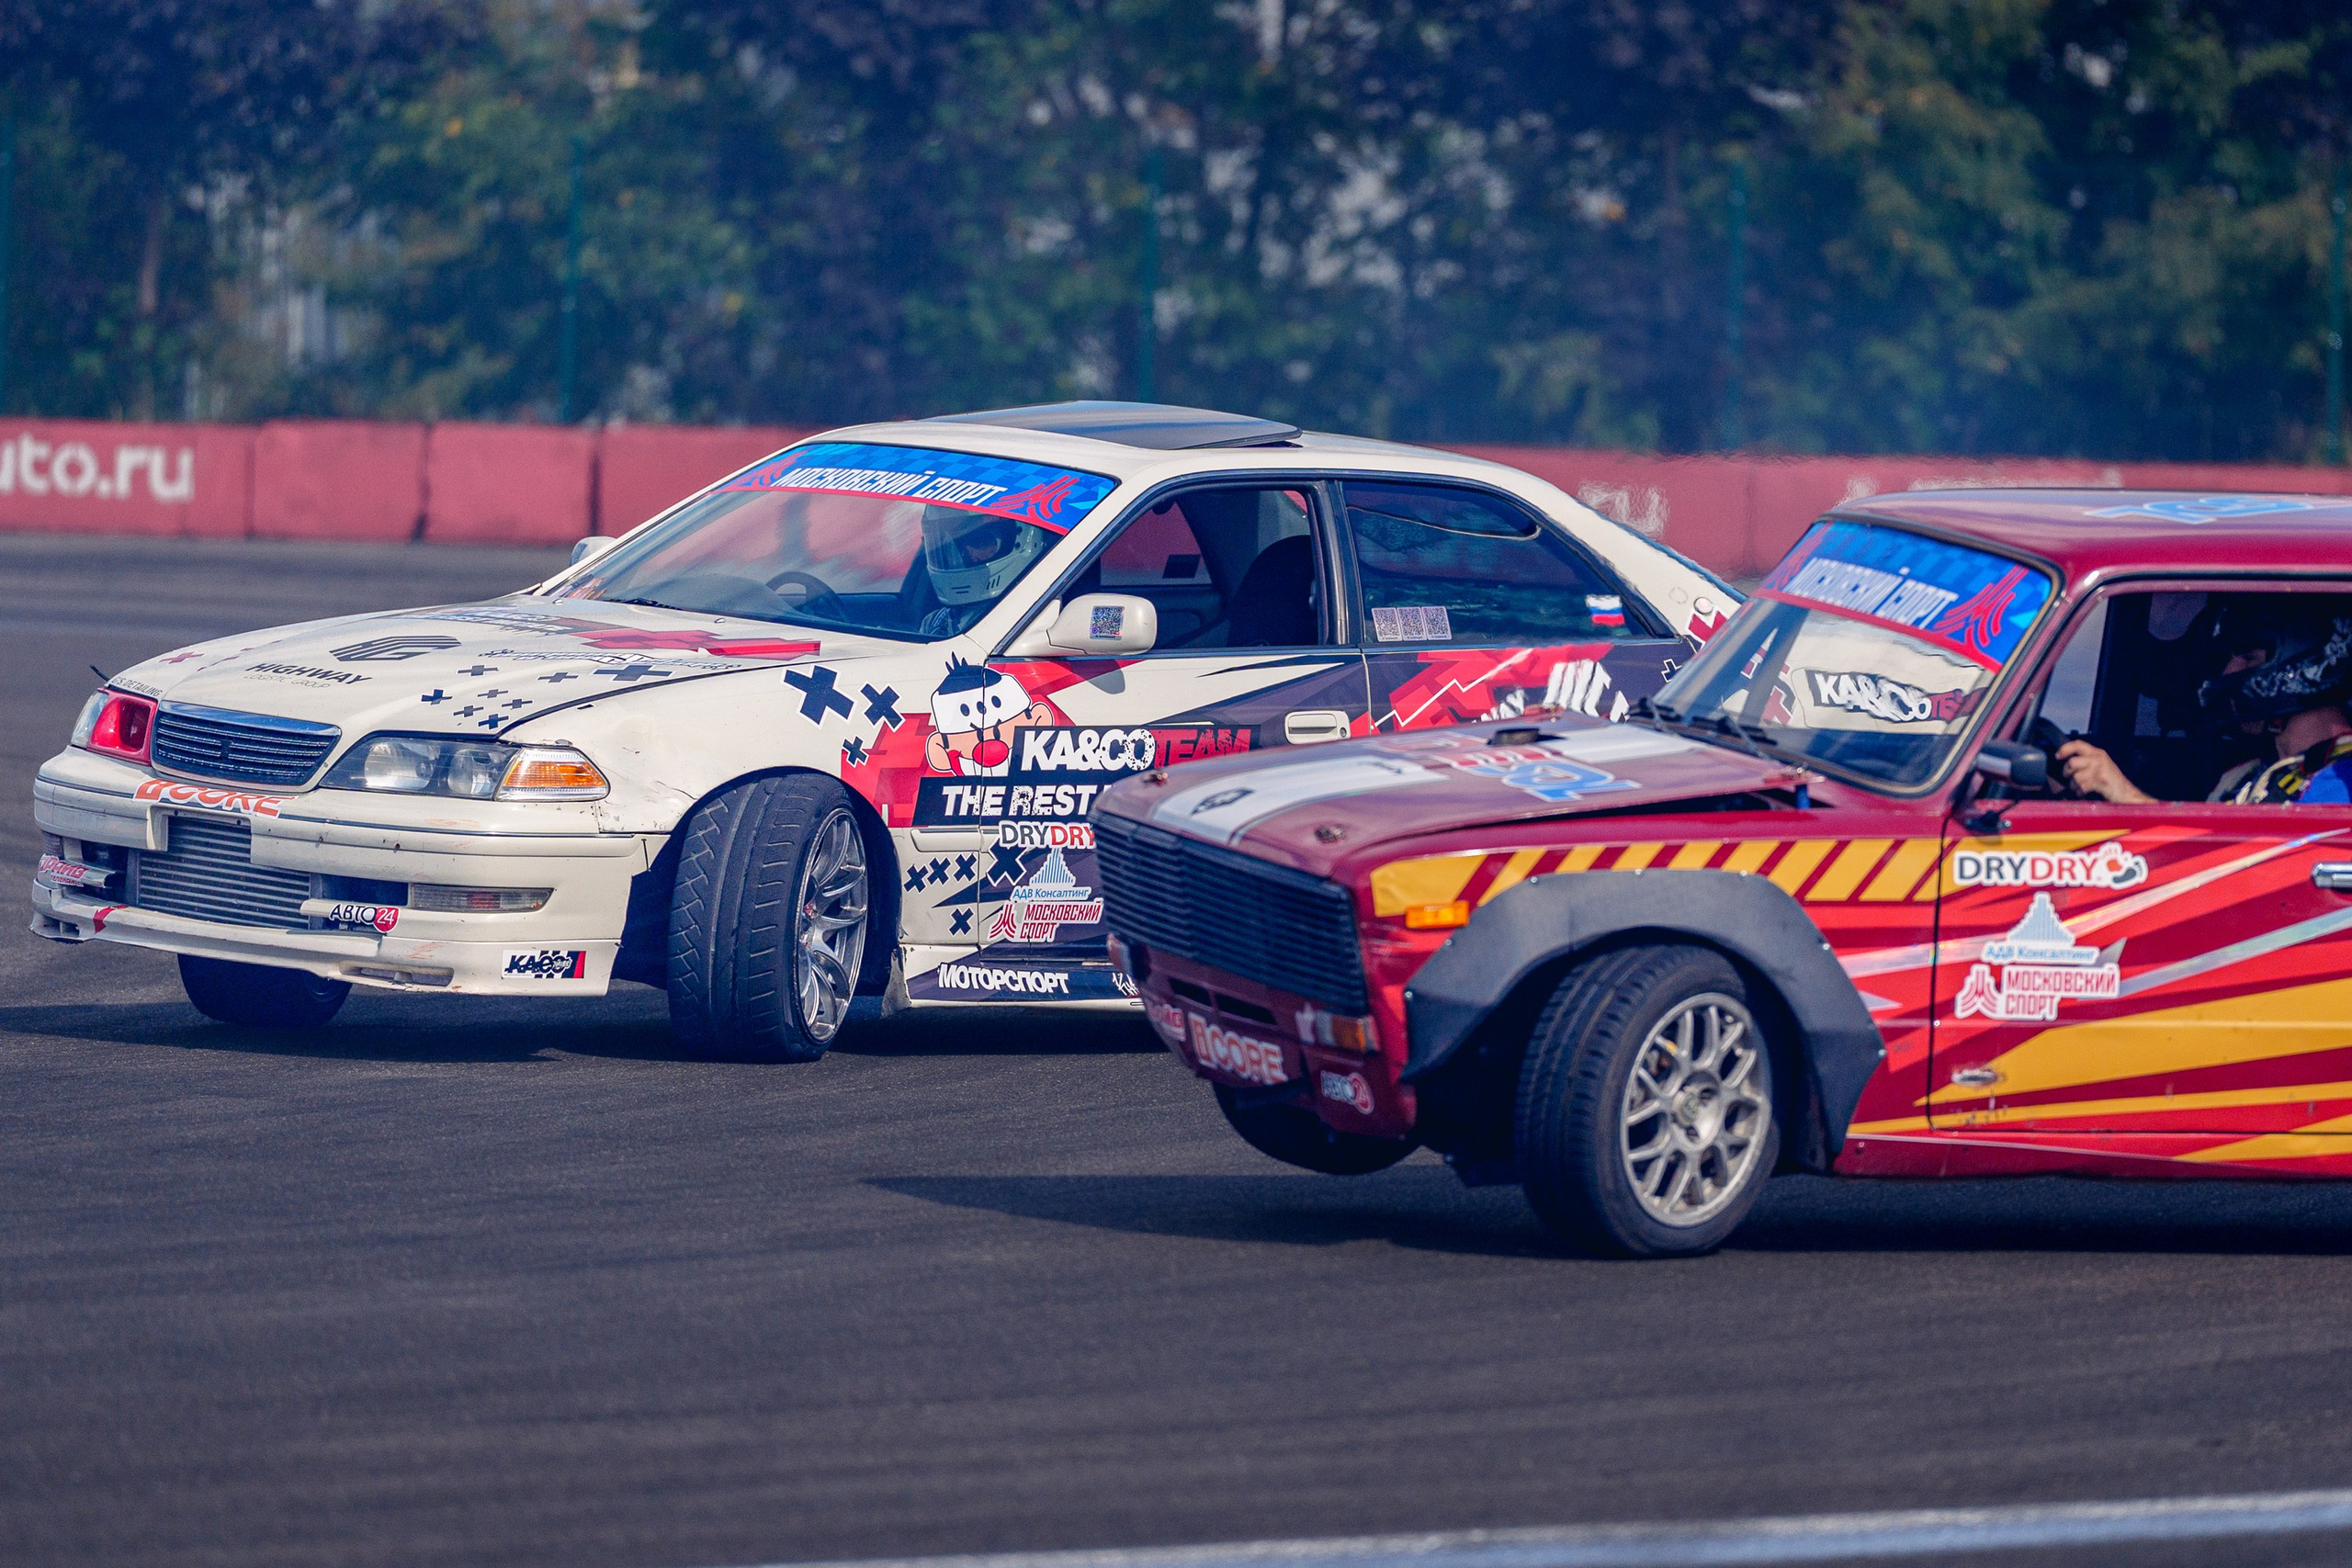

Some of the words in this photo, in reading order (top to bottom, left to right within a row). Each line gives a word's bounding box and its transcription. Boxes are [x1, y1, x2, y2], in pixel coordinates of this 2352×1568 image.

[0, 432, 196, 502] to.ru
[772, 468, 936, 496] МОСКОВСКИЙ
[911, 476, 1009, 506] СПОРТ
[244, 662, 373, 684] HIGHWAY
[942, 784, 1003, 817] THE
[1012, 784, 1098, 817] REST
[1958, 856, 2099, 881] DRYDRY
[1012, 887, 1033, 901] АДВ
[1035, 886, 1089, 899] Консалтинг
[1024, 899, 1102, 922] МОСКОВСКИЙ
[1019, 922, 1057, 940] СПОРТ
[938, 963, 1069, 994] МОТОРСПОРТ
[2007, 965, 2115, 995] МОСКОВСКИЙ
[2005, 994, 2058, 1017] СПОРТ
